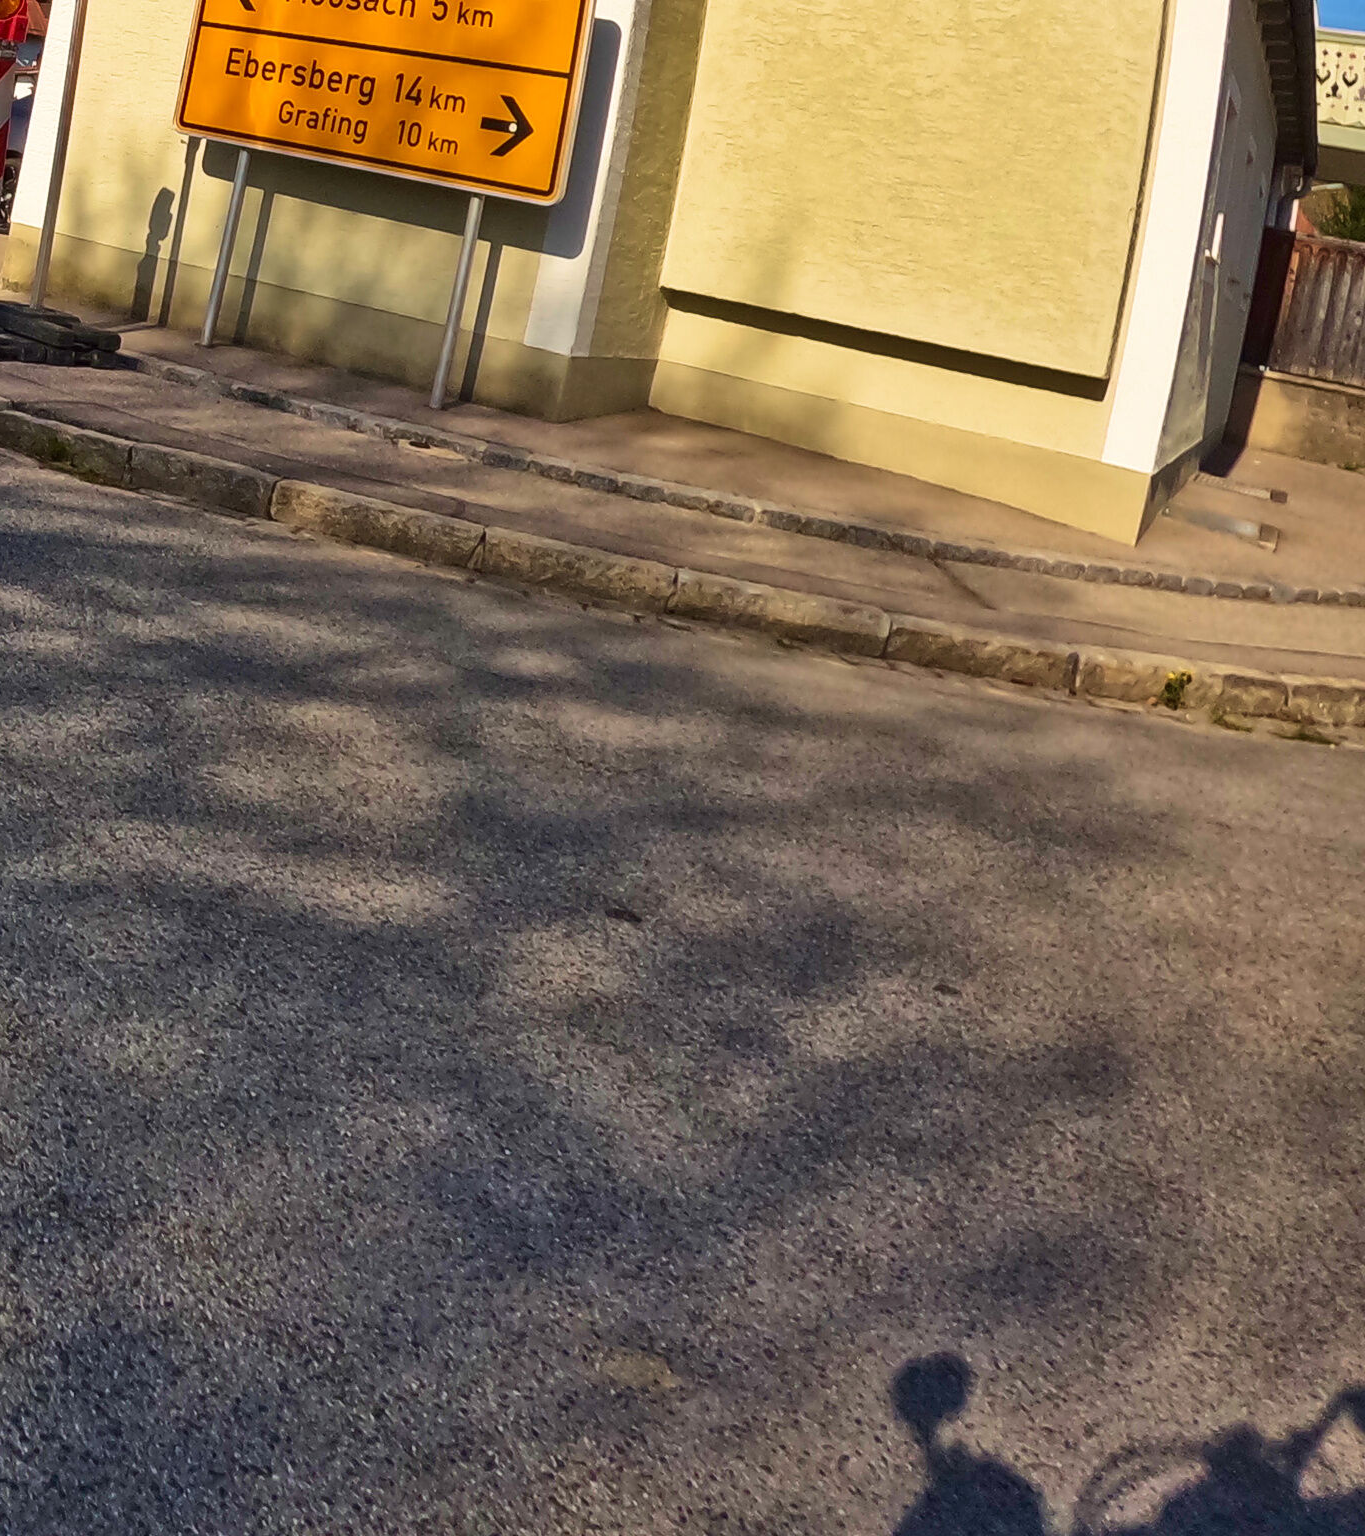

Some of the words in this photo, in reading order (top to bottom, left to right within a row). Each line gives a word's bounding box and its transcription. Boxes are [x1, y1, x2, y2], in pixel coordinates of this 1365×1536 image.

[456, 1, 494, 28] km
[225, 47, 377, 106] Ebersberg
[394, 72, 423, 107] 14
[429, 85, 467, 114] km
[278, 100, 369, 145] Grafing
[397, 119, 423, 148] 10
[427, 131, 459, 156] km
